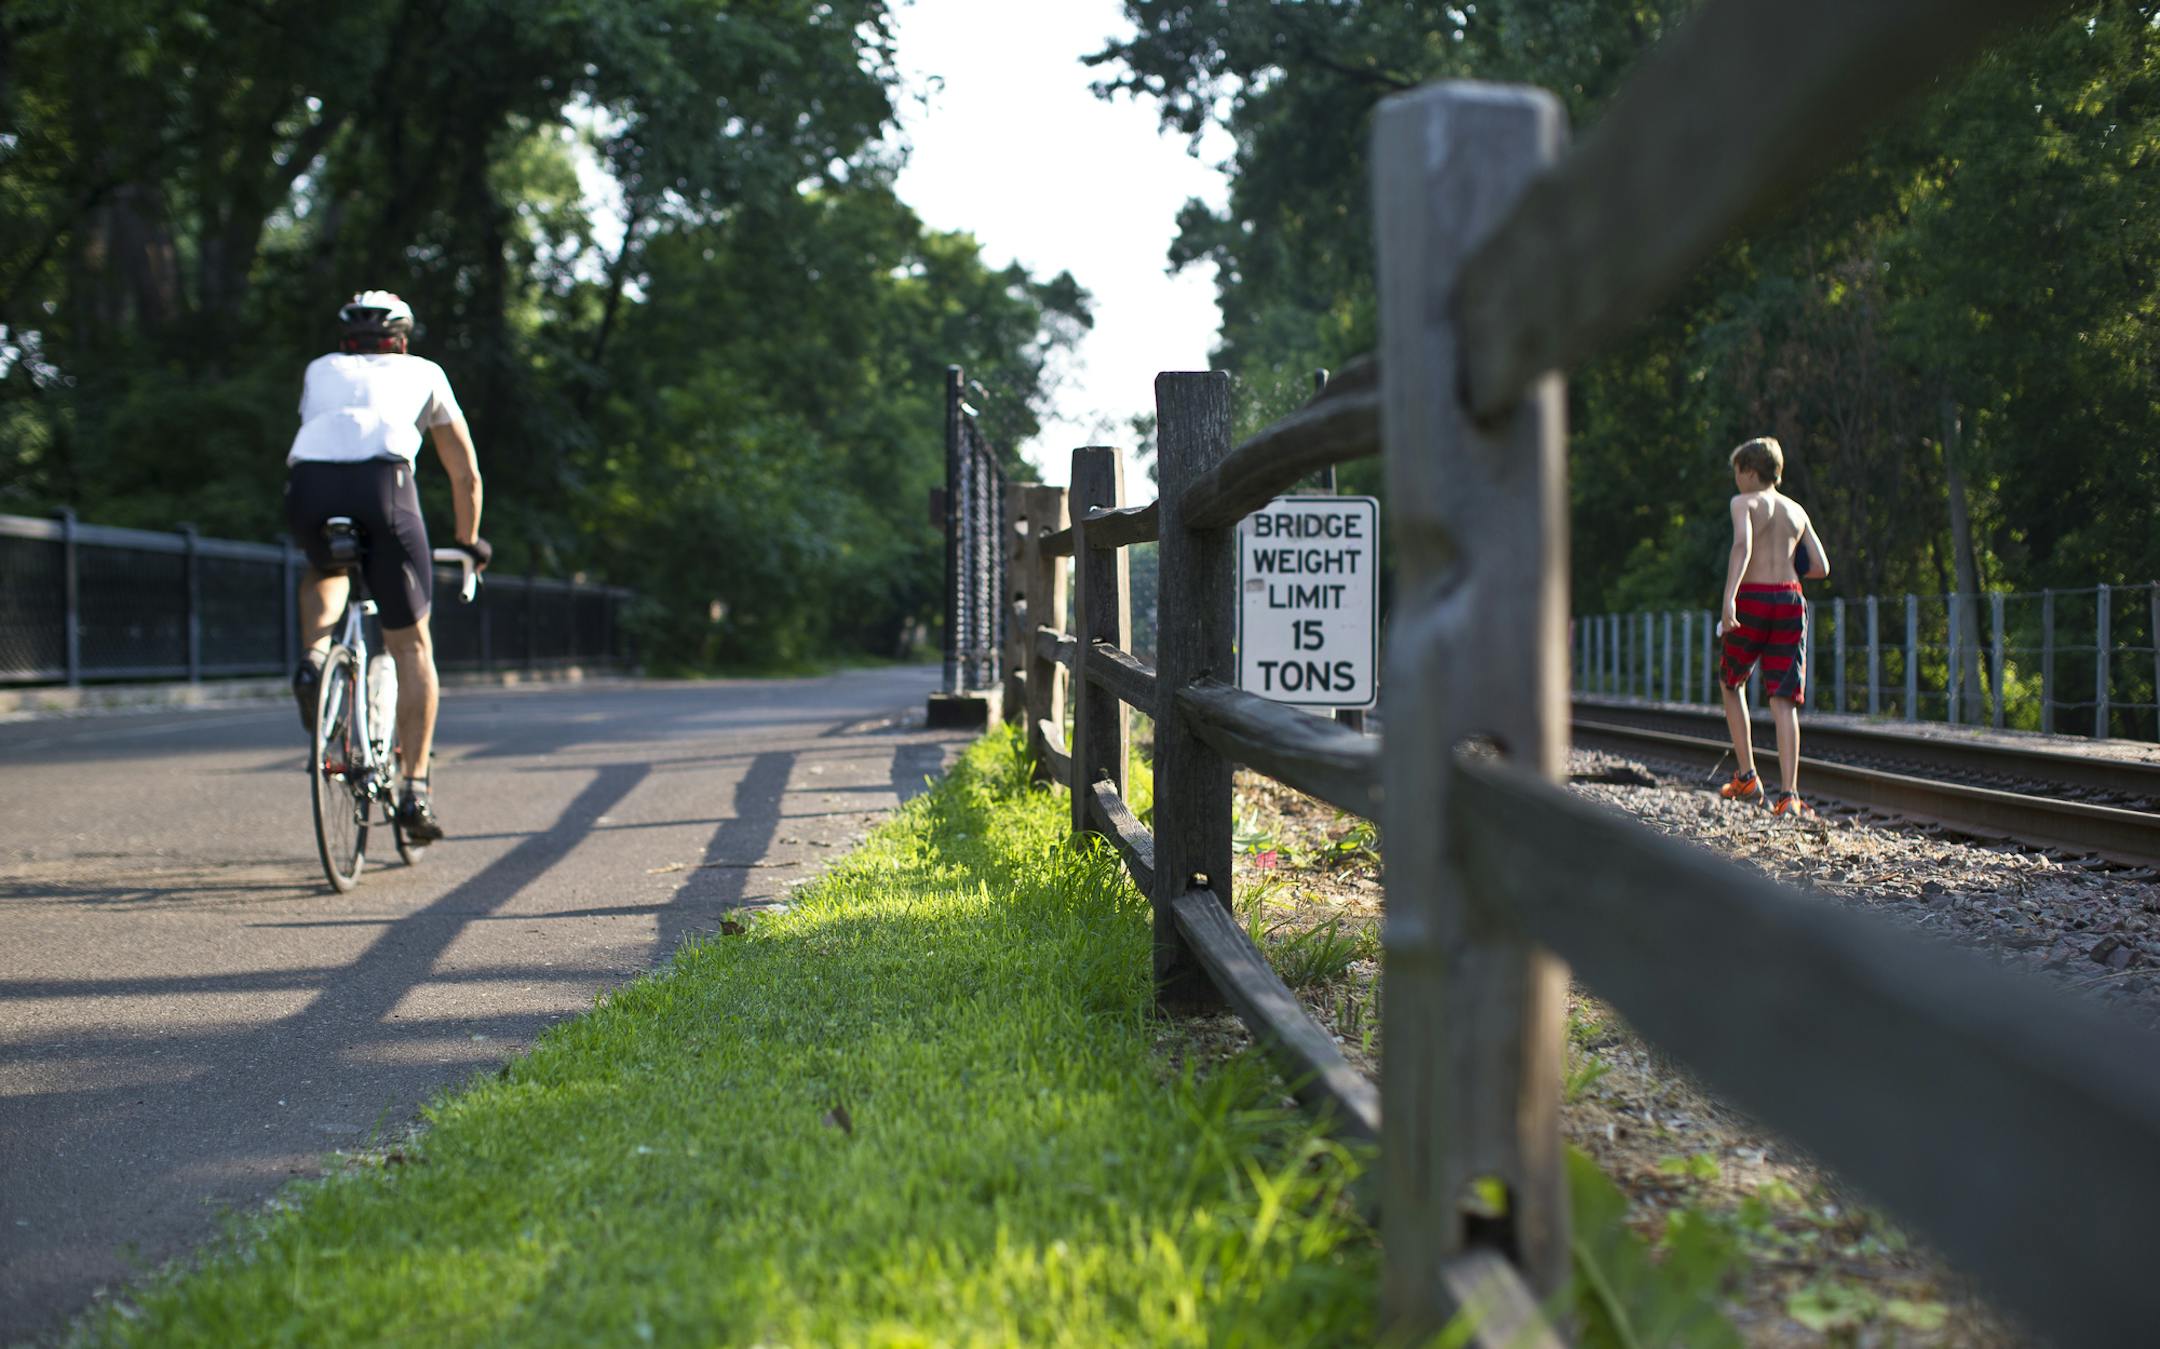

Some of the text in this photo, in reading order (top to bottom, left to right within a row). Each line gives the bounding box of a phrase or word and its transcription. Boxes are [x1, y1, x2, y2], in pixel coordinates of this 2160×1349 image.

[1254, 513, 1363, 538] BRIDGE
[1253, 549, 1361, 574] WEIGHT
[1269, 584, 1346, 609] LIMIT
[1291, 620, 1324, 650] 15
[1257, 661, 1356, 692] TONS
